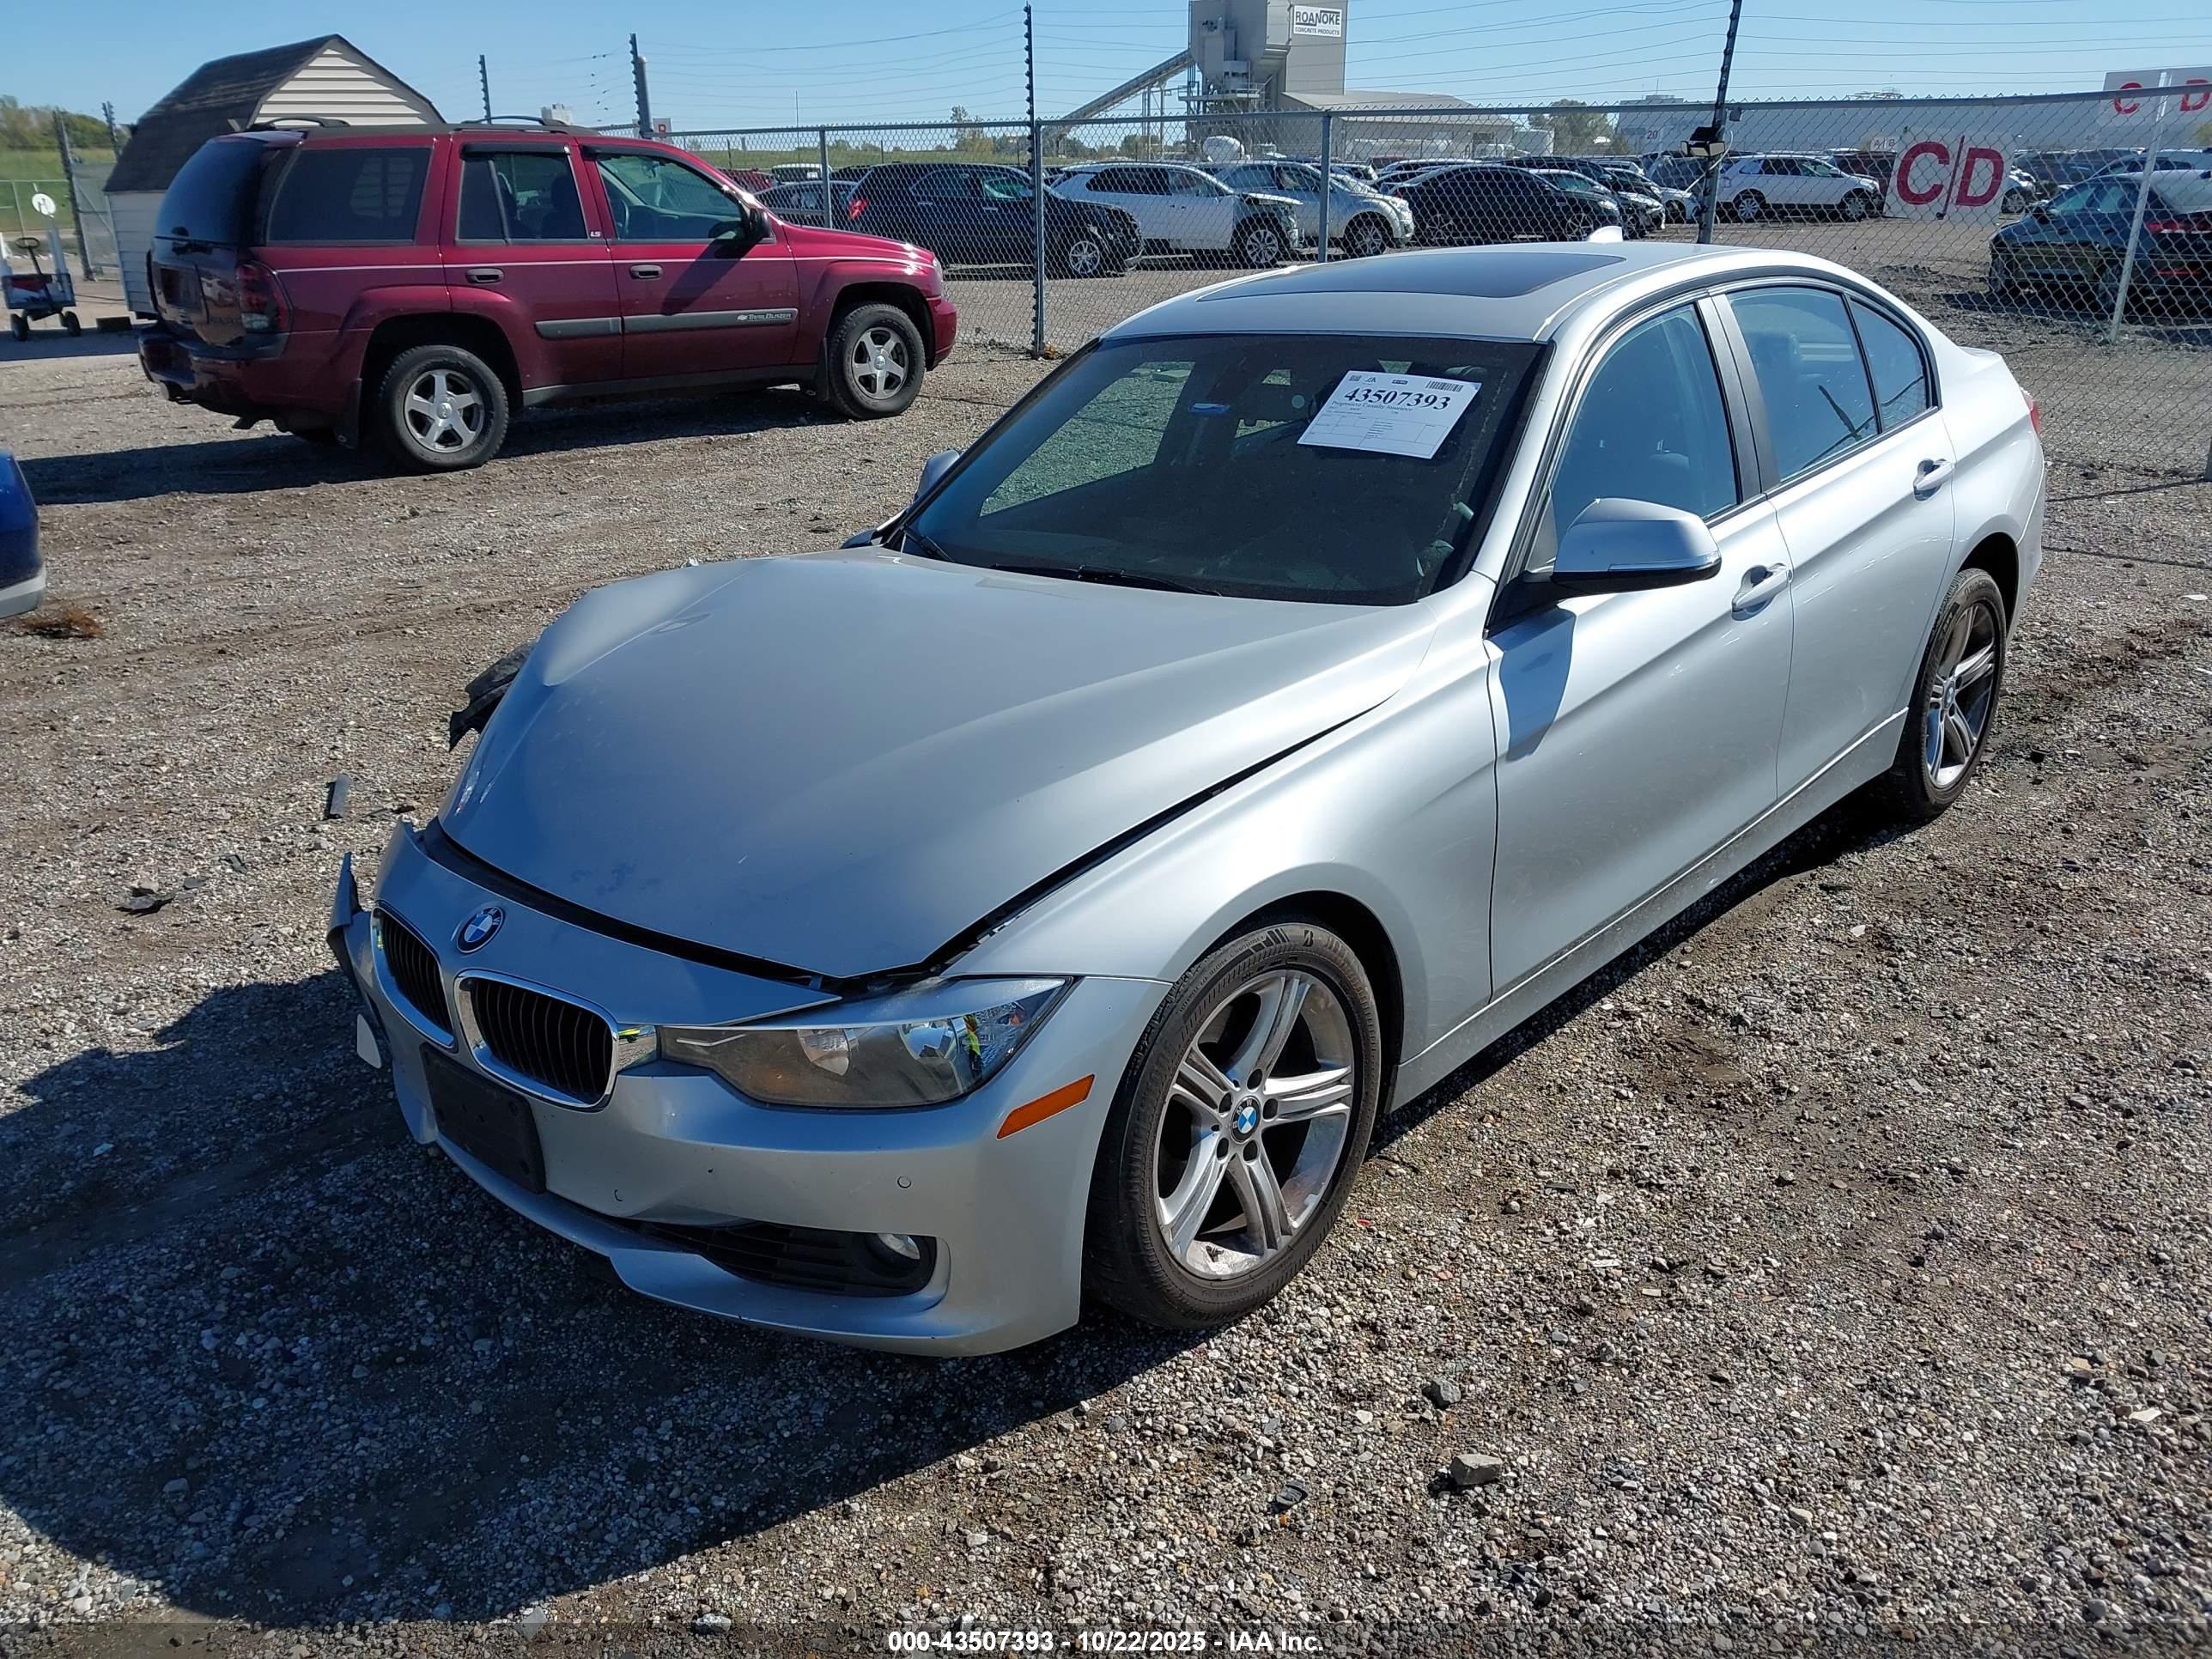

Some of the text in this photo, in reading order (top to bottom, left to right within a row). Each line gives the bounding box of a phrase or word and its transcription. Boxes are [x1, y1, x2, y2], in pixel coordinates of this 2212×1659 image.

[1295, 10, 1340, 26] ROANOKE
[1647, 130, 1658, 139] 20
[1344, 387, 1451, 410] 43507393
